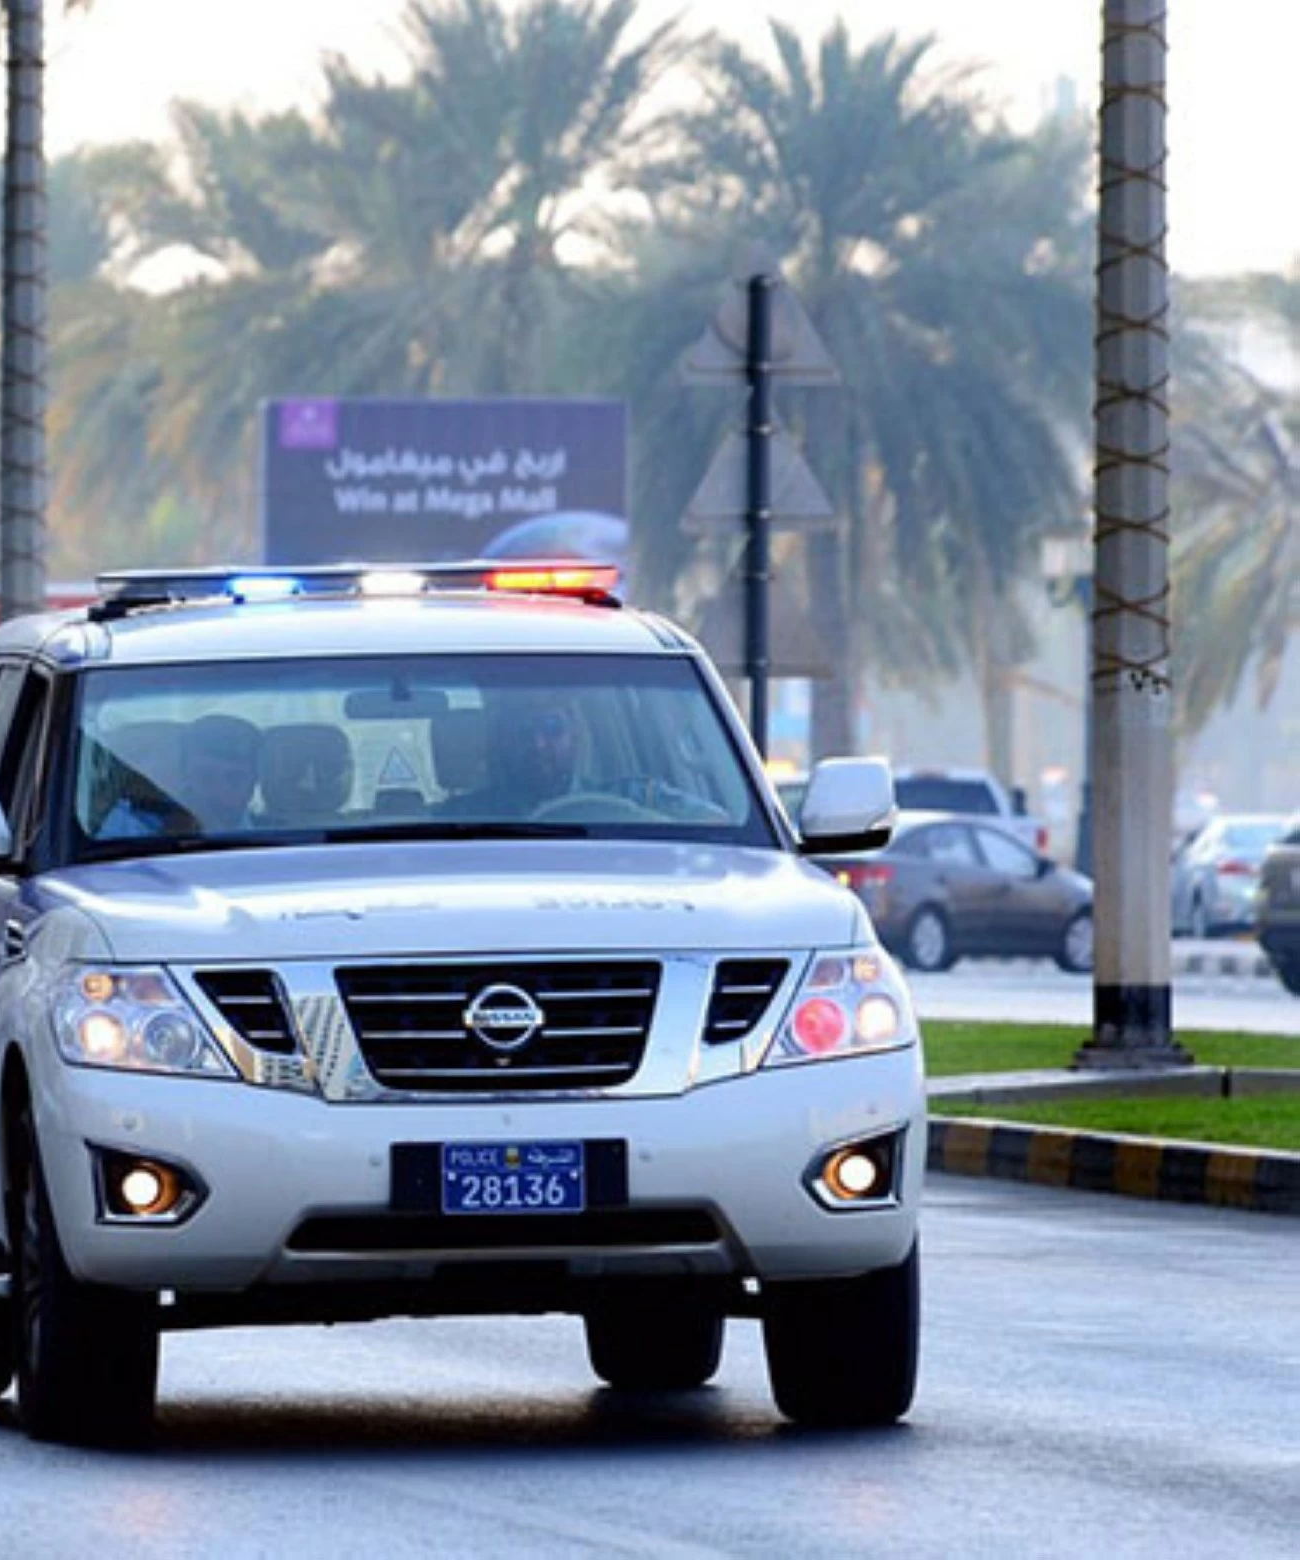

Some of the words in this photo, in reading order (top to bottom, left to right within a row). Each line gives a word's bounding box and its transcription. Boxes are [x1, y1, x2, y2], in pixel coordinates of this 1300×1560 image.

[458, 451, 508, 486] في
[333, 486, 387, 513] Win
[392, 490, 419, 513] at
[424, 486, 494, 520] Mega
[499, 486, 557, 512] Mall
[461, 1174, 566, 1206] 28136
